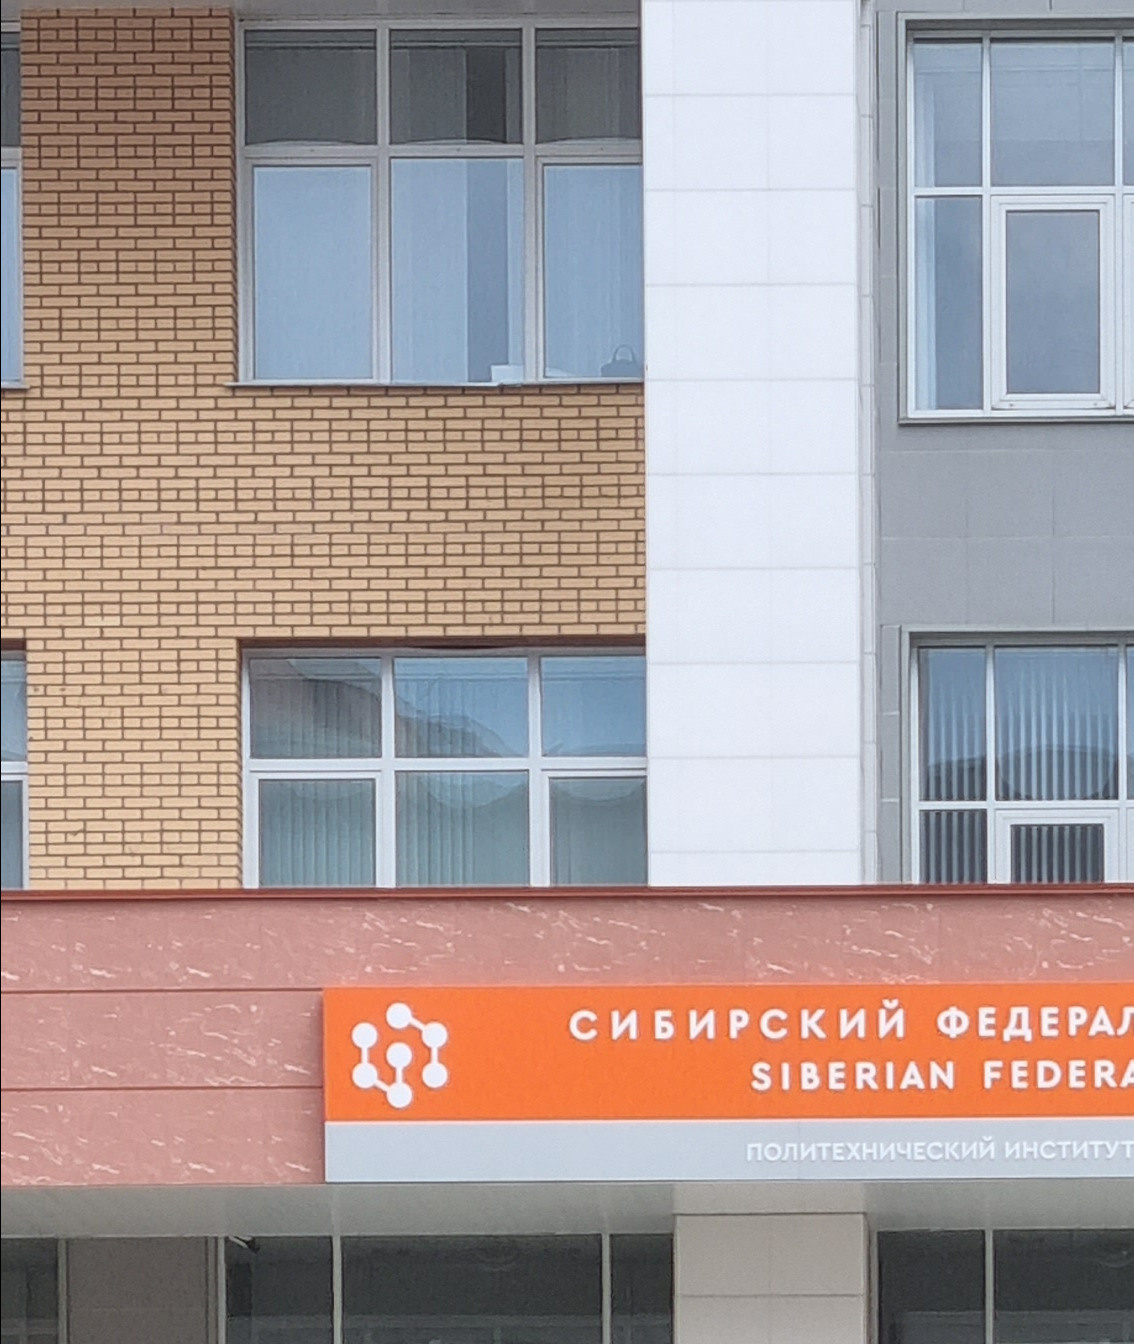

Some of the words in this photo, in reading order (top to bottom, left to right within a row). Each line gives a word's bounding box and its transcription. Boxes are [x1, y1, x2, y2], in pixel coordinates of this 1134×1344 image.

[569, 998, 906, 1041] СИБИРСКИЙ
[750, 1060, 955, 1091] SIBERIAN
[746, 1136, 996, 1162] ПОЛИТЕХНИЧЕСКИЙ
